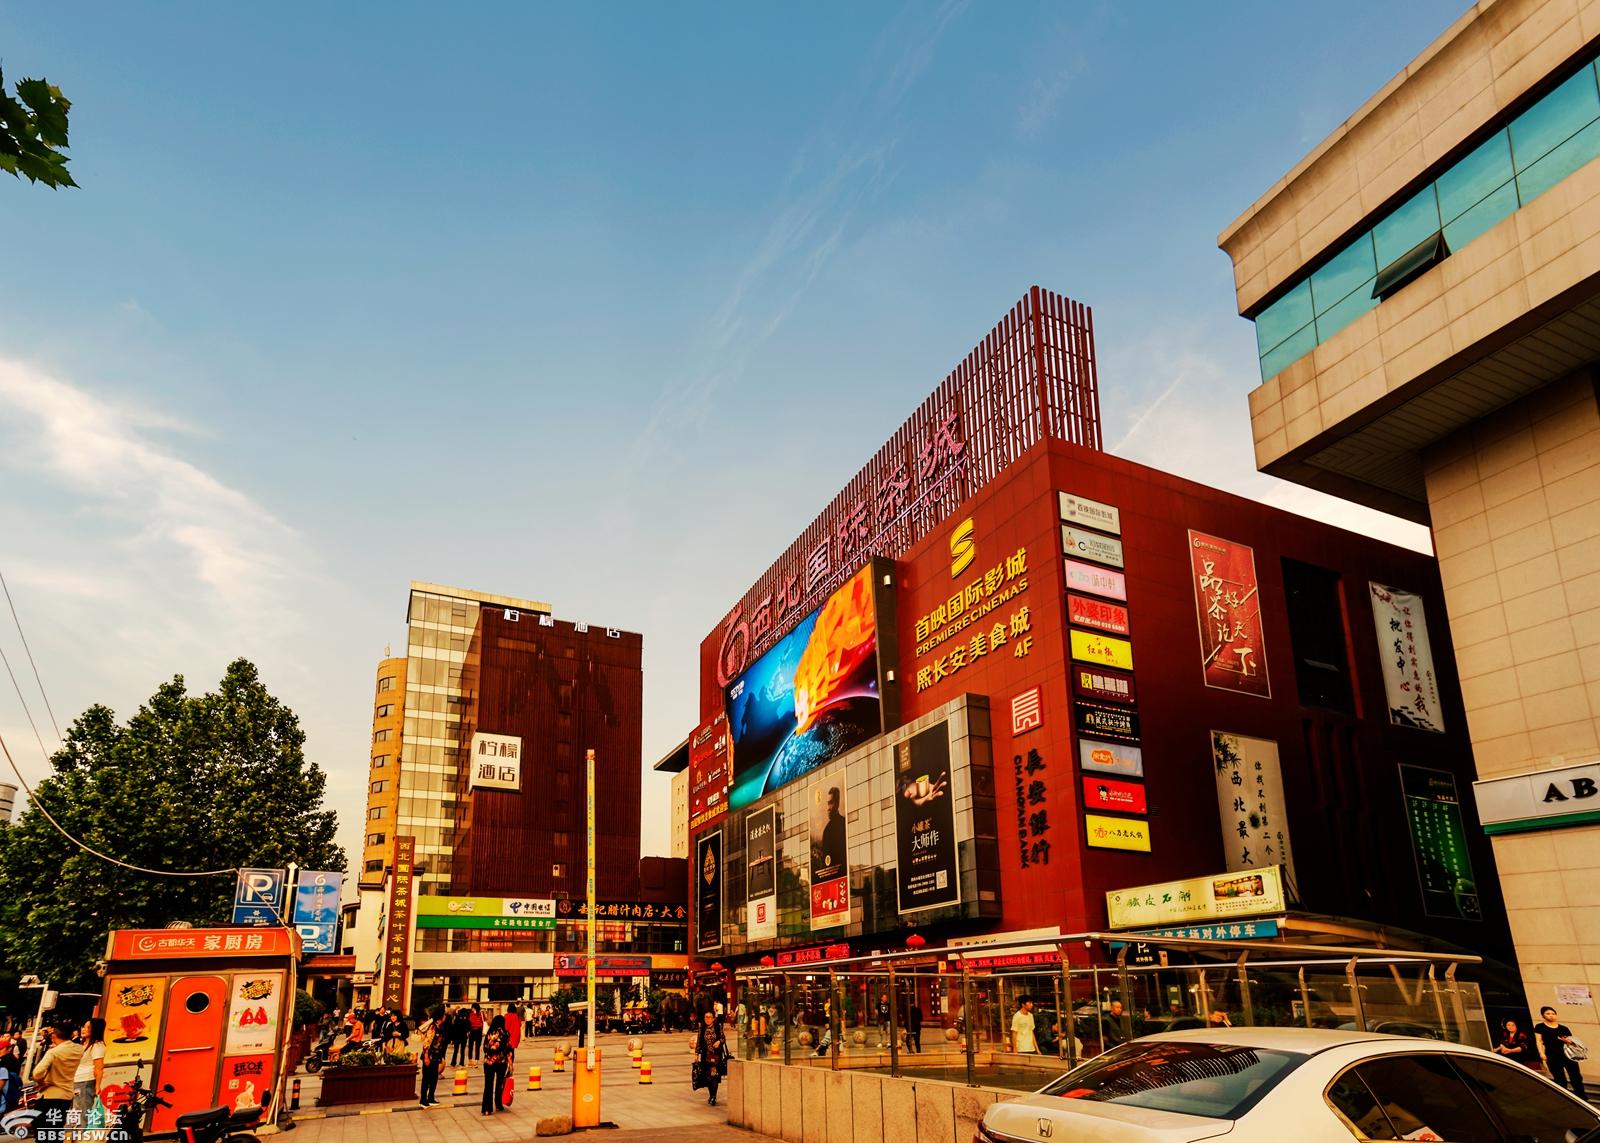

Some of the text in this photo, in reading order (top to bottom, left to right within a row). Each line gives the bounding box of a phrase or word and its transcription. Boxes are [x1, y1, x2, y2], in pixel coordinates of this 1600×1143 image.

[915, 547, 1028, 643] 首映国际影城
[503, 607, 620, 639] 柠檬酒店
[1072, 598, 1126, 625] 外婆印象
[917, 606, 1031, 693] 熙长安美食城
[1014, 636, 1032, 658] 4F
[1389, 617, 1411, 692] 批发中心
[478, 740, 518, 759] 柠檬
[478, 763, 516, 782] 酒店
[1230, 770, 1254, 866] 西北最大
[911, 829, 940, 852] 大师作
[246, 874, 273, 902] P
[203, 933, 263, 950] 家厨房
